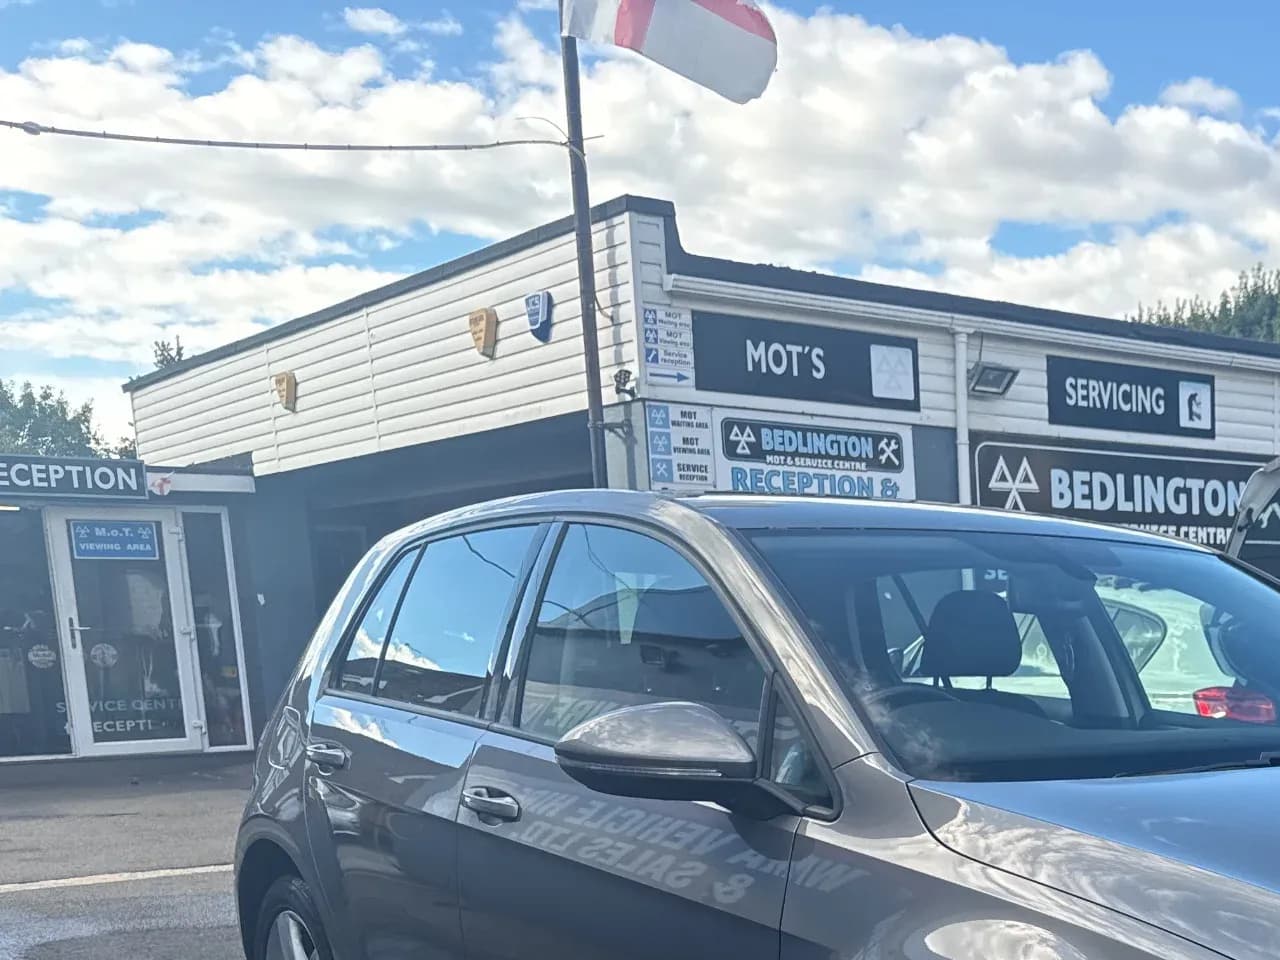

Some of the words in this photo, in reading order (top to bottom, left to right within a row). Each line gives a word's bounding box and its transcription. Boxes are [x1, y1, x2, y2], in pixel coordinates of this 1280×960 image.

[745, 339, 827, 380] MOT'S
[1065, 376, 1166, 415] SERVICING
[680, 410, 697, 420] MOT
[682, 436, 699, 446] MOT
[760, 427, 874, 459] BEDLINGTON
[676, 462, 709, 474] SERVICE
[766, 454, 785, 466] MOT
[794, 457, 833, 470] SERVICE
[834, 460, 868, 472] CENTRE
[679, 473, 709, 482] RECEPTION
[731, 466, 875, 497] RECEPTION
[1050, 468, 1246, 518] BEDLINGTON
[79, 543, 122, 551] VIEWING
[126, 543, 152, 551] AREA
